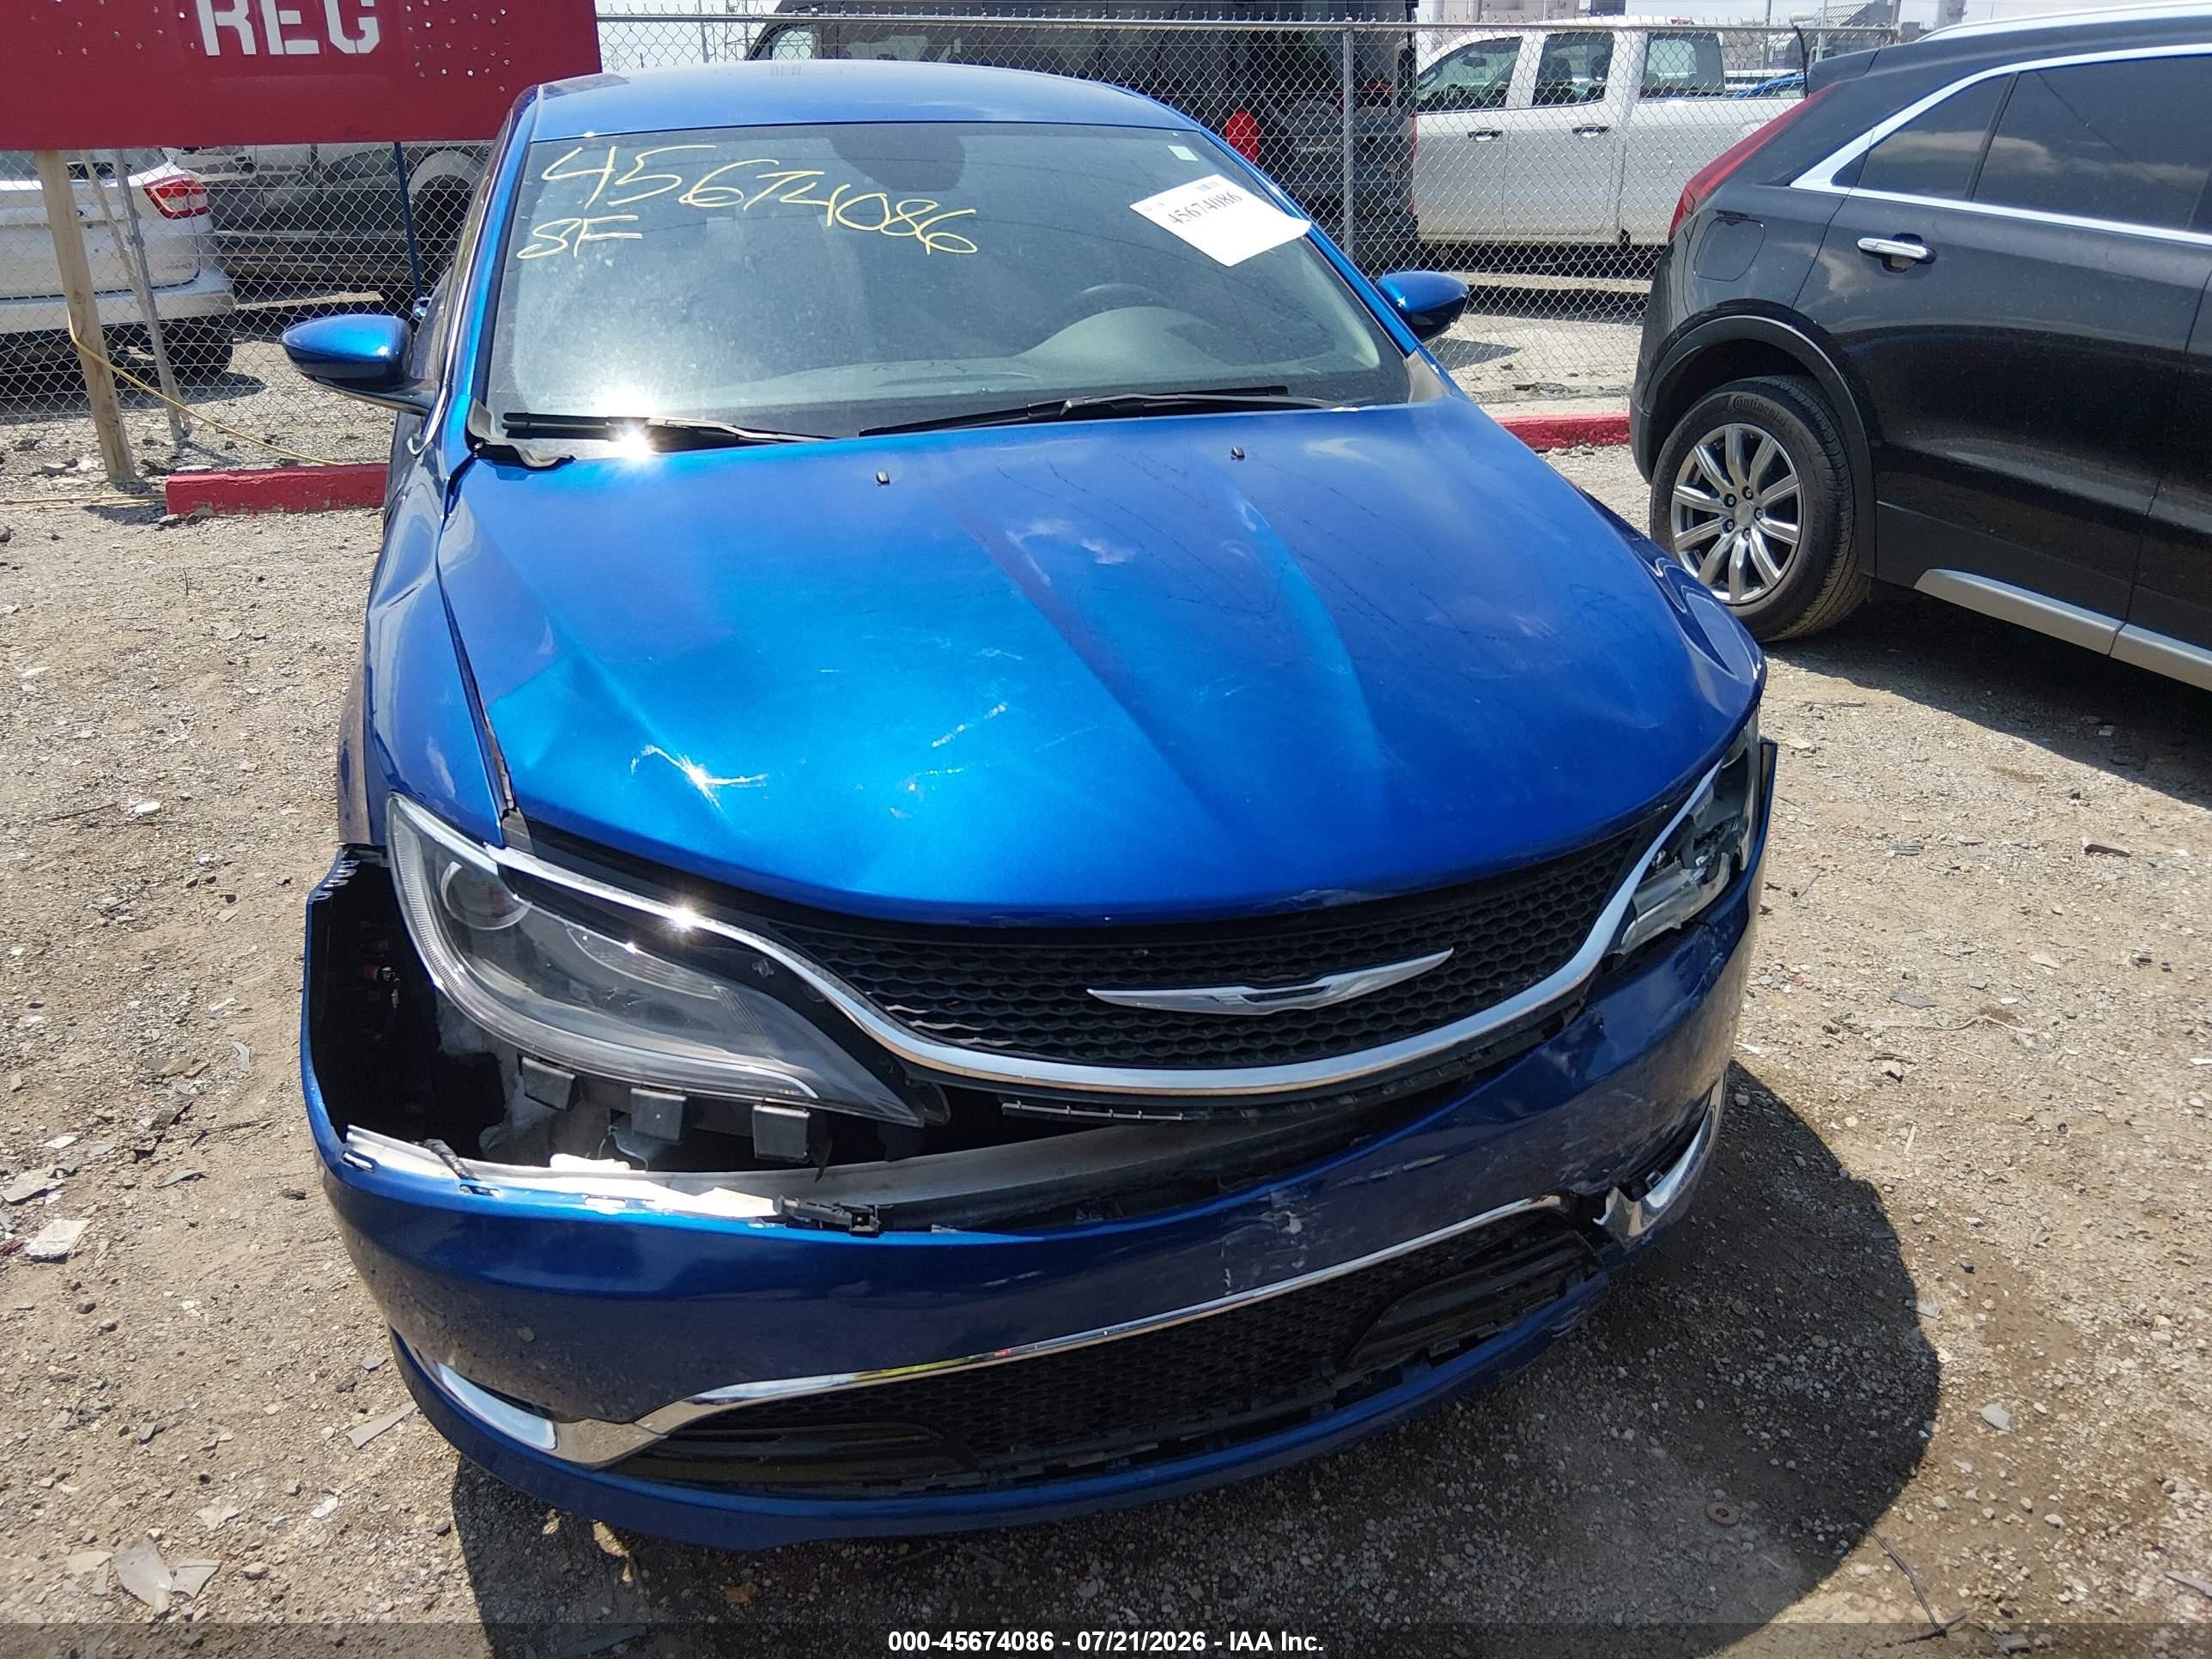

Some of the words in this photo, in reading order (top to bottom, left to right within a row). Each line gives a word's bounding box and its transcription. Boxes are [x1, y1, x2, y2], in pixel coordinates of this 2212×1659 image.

[196, 0, 380, 56] REG
[541, 144, 978, 256] 45674086
[1167, 190, 1243, 225] 45674086
[1732, 394, 1790, 428] Continental
